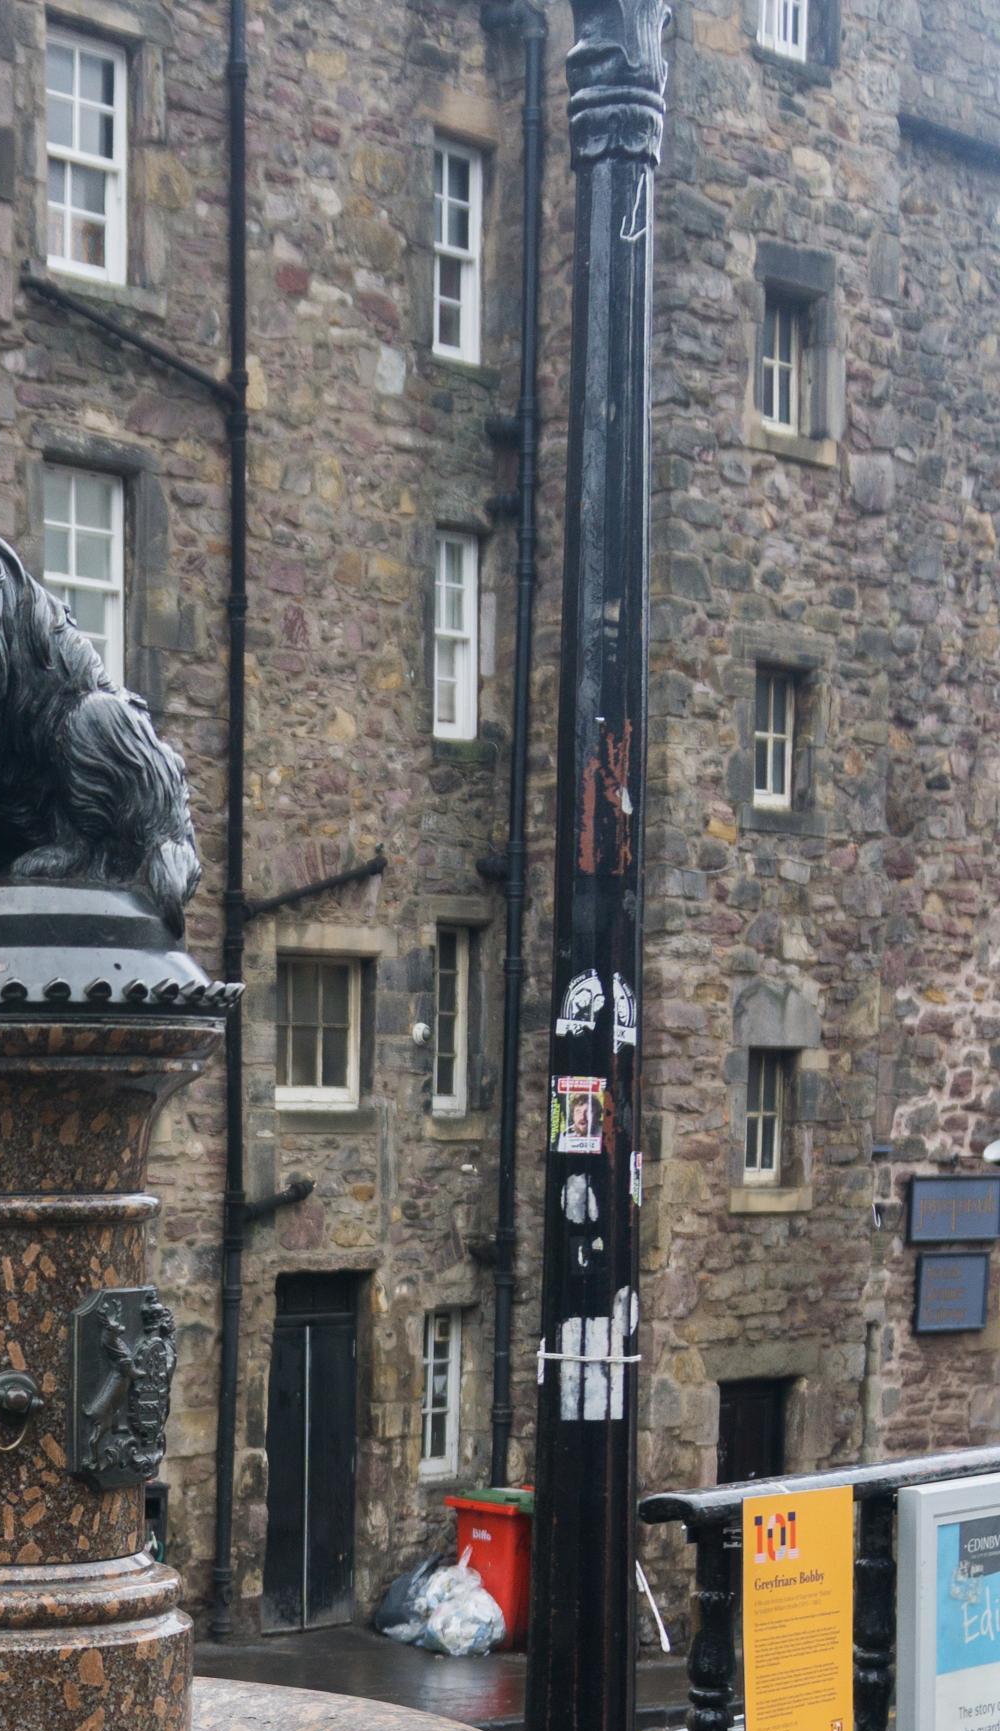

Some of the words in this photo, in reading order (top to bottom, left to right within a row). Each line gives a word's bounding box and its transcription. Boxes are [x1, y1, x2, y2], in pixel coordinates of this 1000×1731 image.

[473, 1528, 491, 1541] Biffa
[754, 1511, 800, 1564] 101
[754, 1573, 797, 1592] Greyfriars
[799, 1569, 825, 1585] Bobby
[958, 1705, 972, 1719] The
[974, 1702, 995, 1717] story
